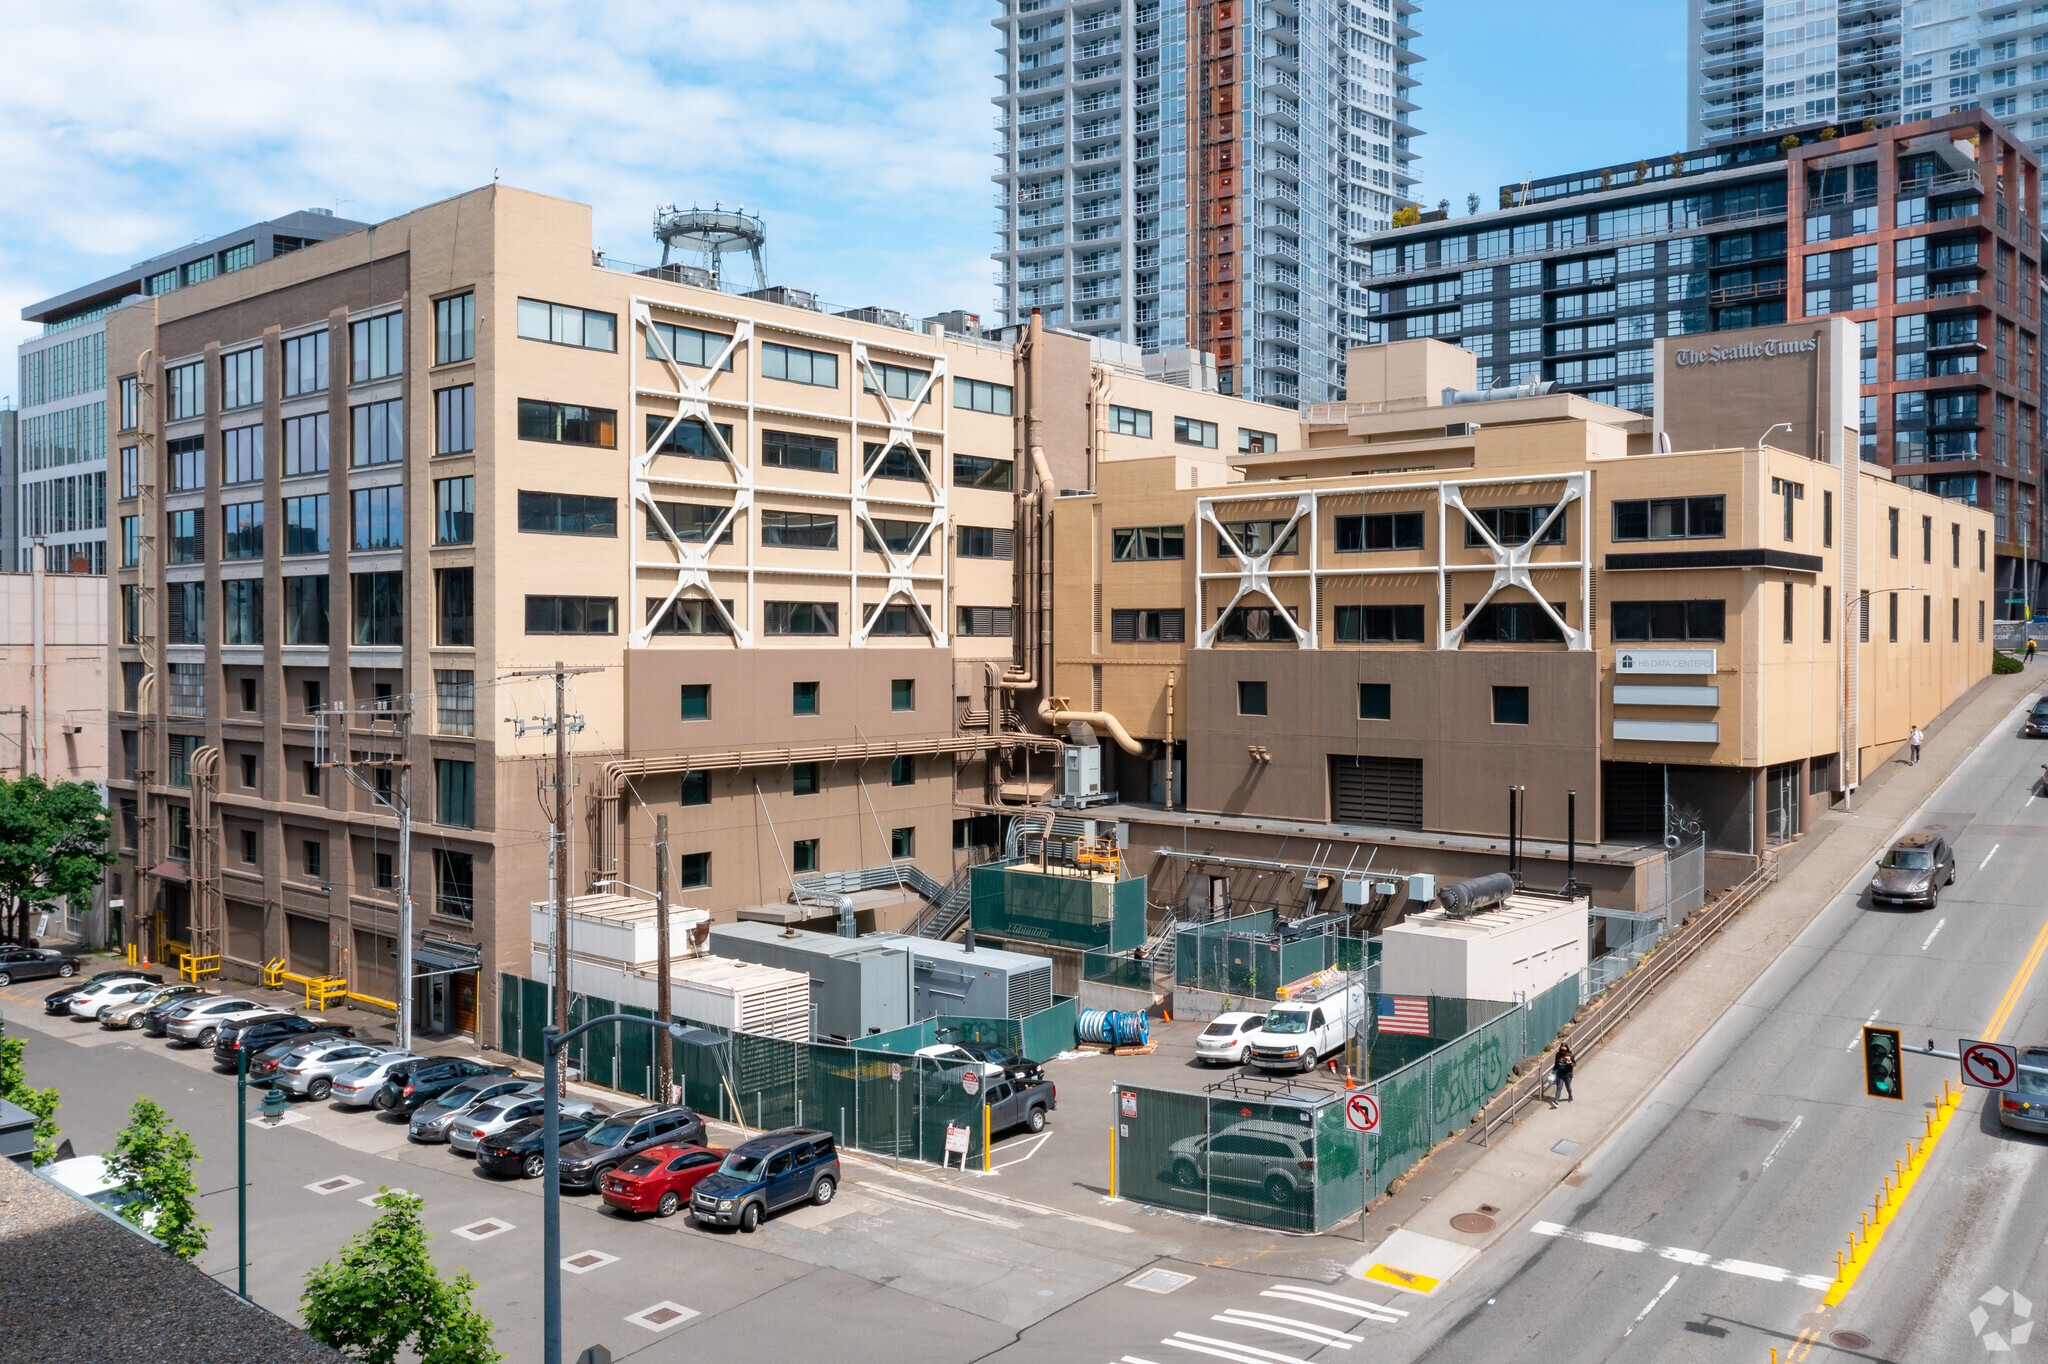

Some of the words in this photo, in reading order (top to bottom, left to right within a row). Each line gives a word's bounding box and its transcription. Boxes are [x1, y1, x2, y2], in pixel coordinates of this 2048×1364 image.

[1676, 347, 1707, 366] The
[1709, 342, 1763, 363] Seattle
[1764, 337, 1816, 357] Times
[1651, 660, 1671, 668] DATA
[1672, 660, 1712, 669] CENTERS
